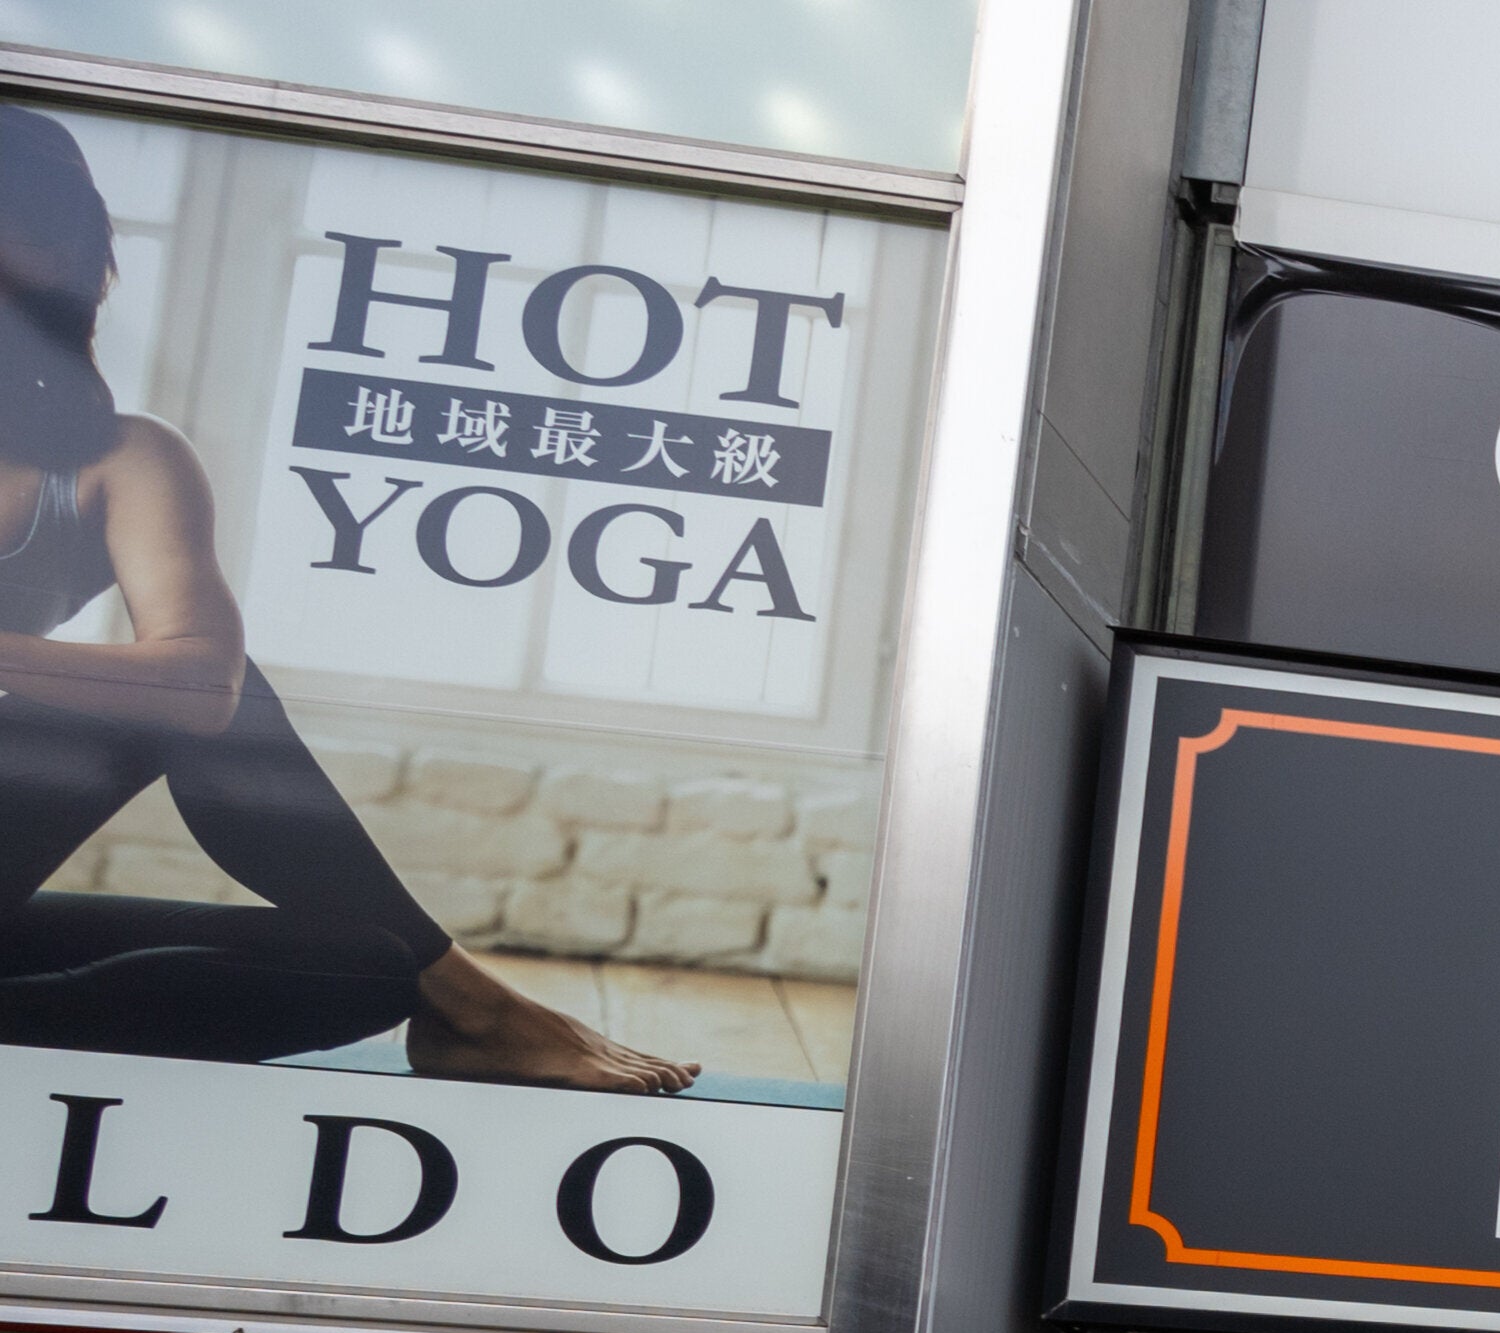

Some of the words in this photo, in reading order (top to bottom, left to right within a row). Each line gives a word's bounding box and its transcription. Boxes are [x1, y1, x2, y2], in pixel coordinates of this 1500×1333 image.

[308, 231, 843, 408] HOT
[345, 387, 780, 488] 地域最大級
[288, 466, 817, 623] YOGA
